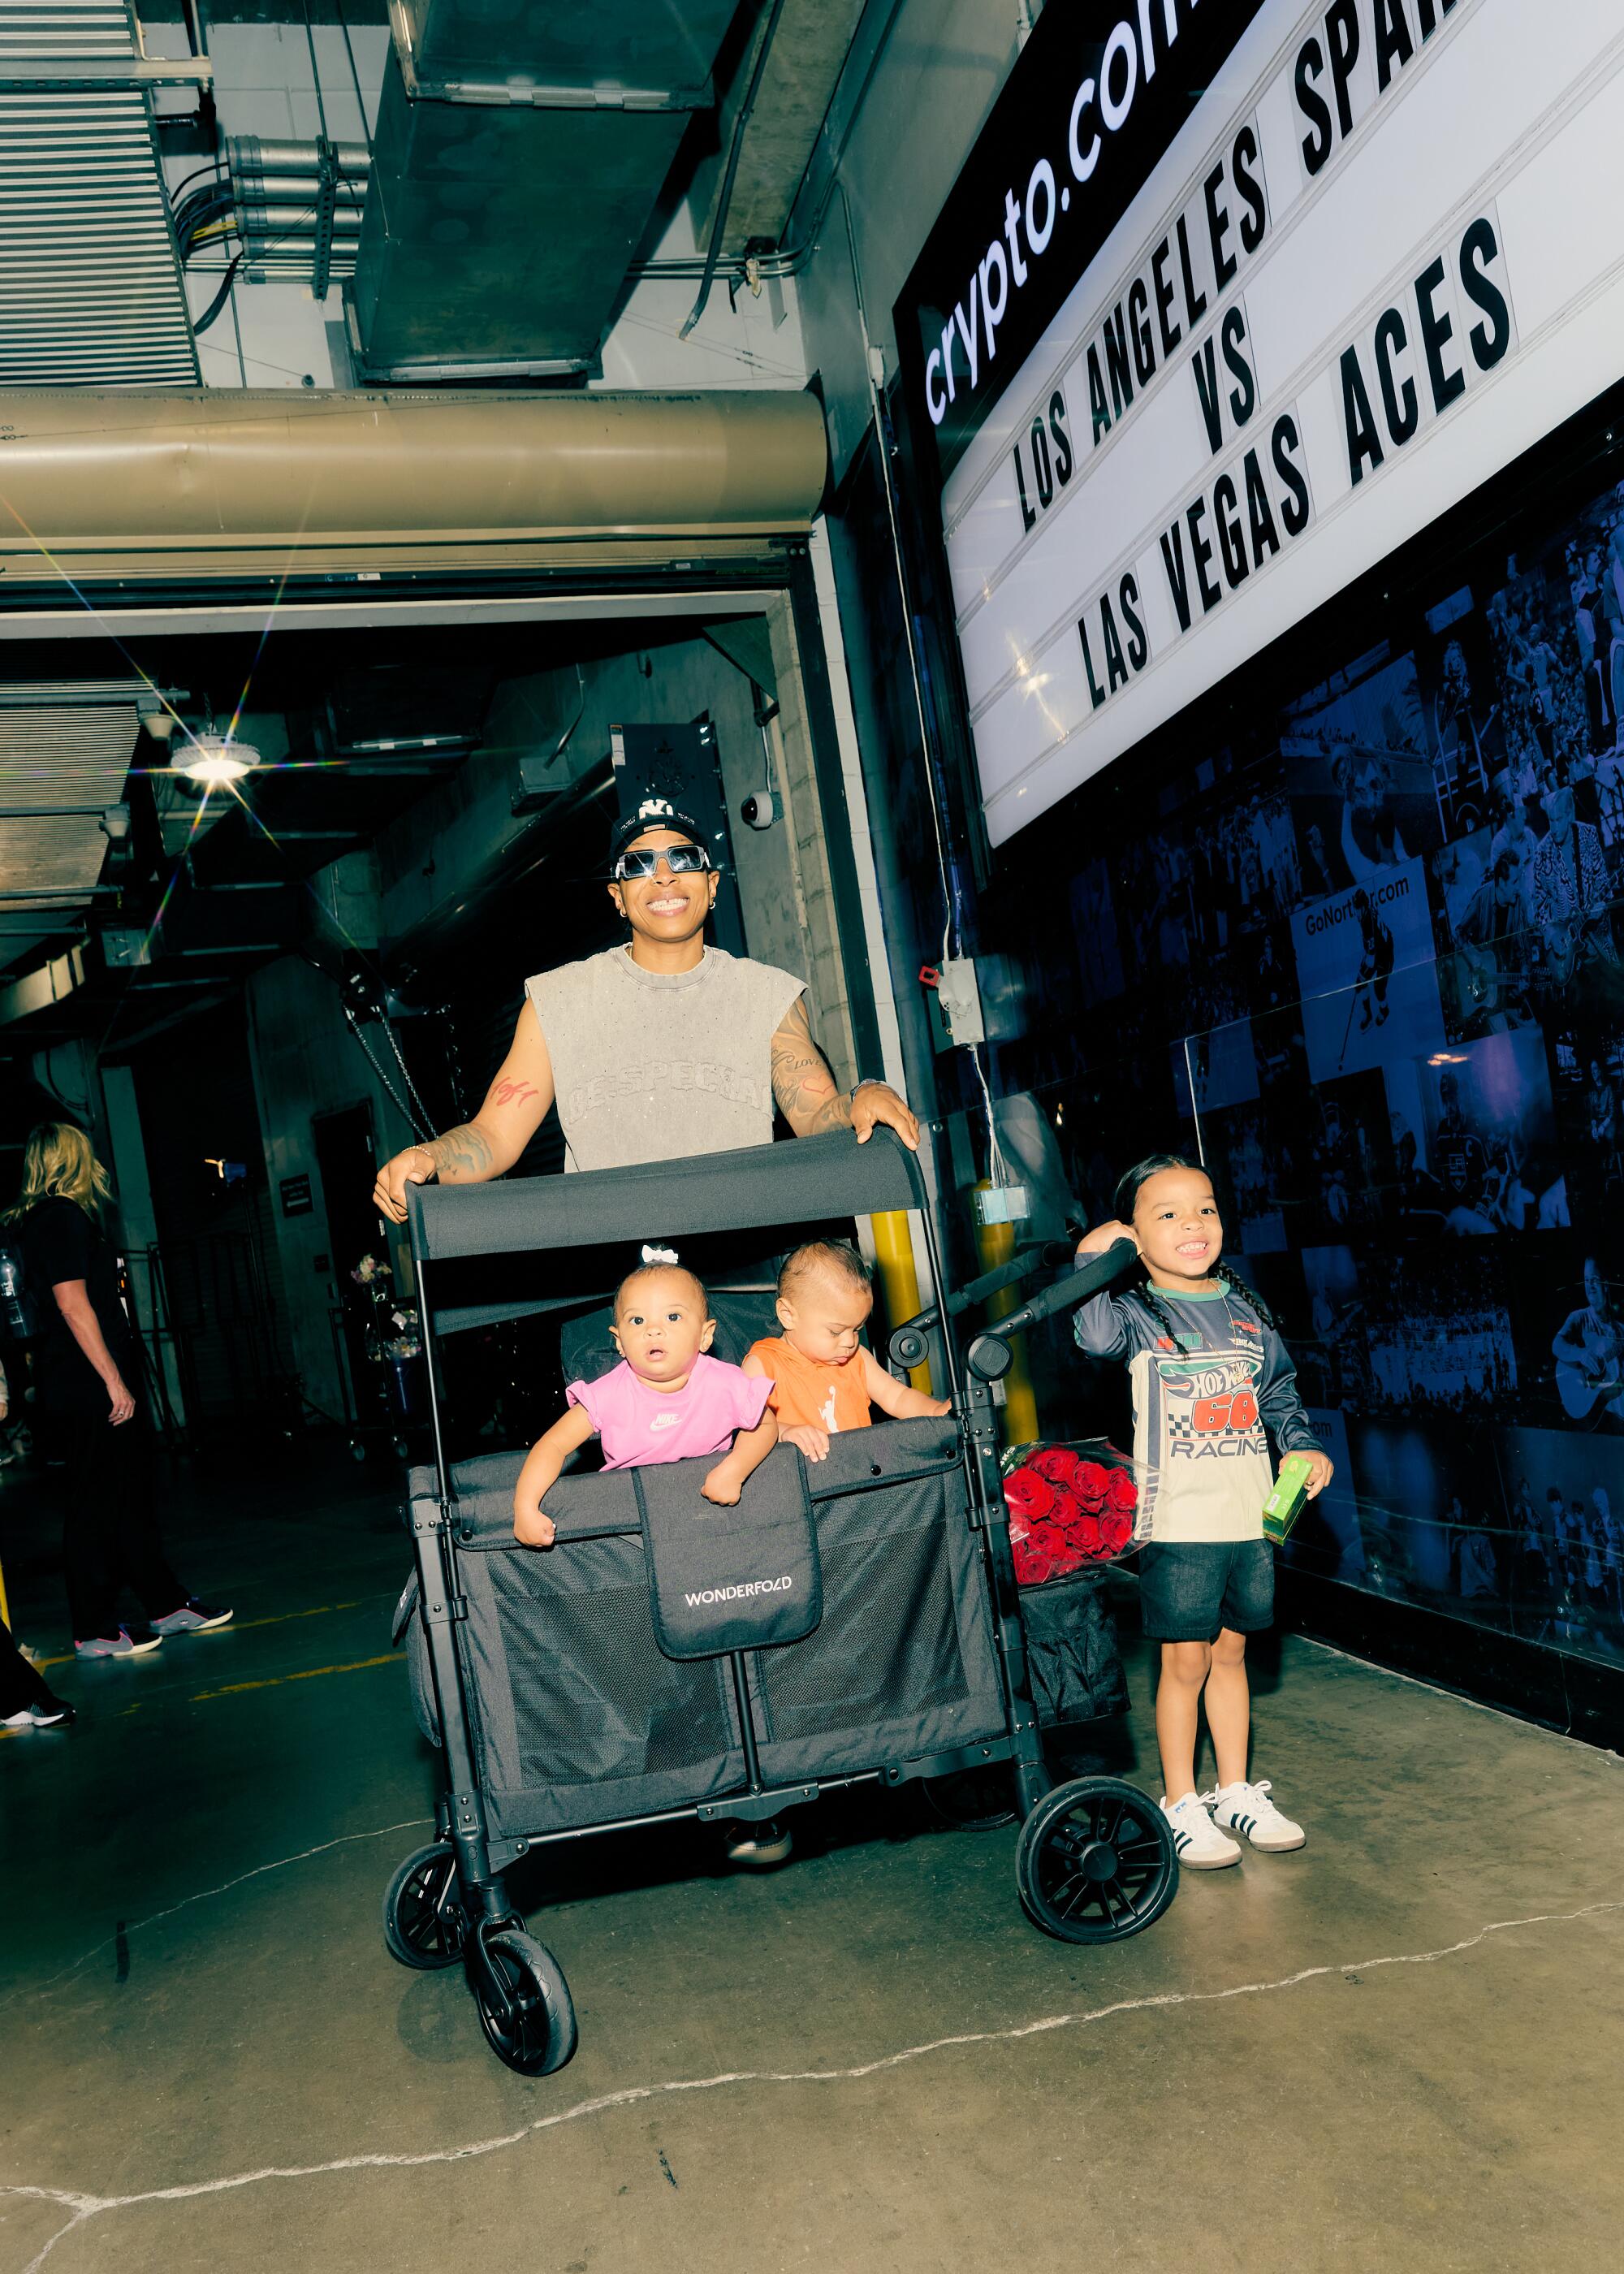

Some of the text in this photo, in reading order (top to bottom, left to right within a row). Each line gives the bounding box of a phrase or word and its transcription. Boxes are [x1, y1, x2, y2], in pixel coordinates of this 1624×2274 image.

[1011, 390, 1072, 535] LOS
[1086, 125, 1267, 448] ANGELES
[1191, 305, 1257, 456] VS
[1078, 217, 1511, 710] LAS VEGAS ACES
[1305, 876, 1410, 936] GoNortr.com
[794, 1058, 823, 1070] LOVE
[1186, 1370, 1224, 1399] HOT
[655, 1413, 679, 1424] NIKE
[1194, 1392, 1258, 1433] 68
[1170, 1436, 1268, 1459] RACING
[685, 1576, 793, 1606] WONDERFOLD
